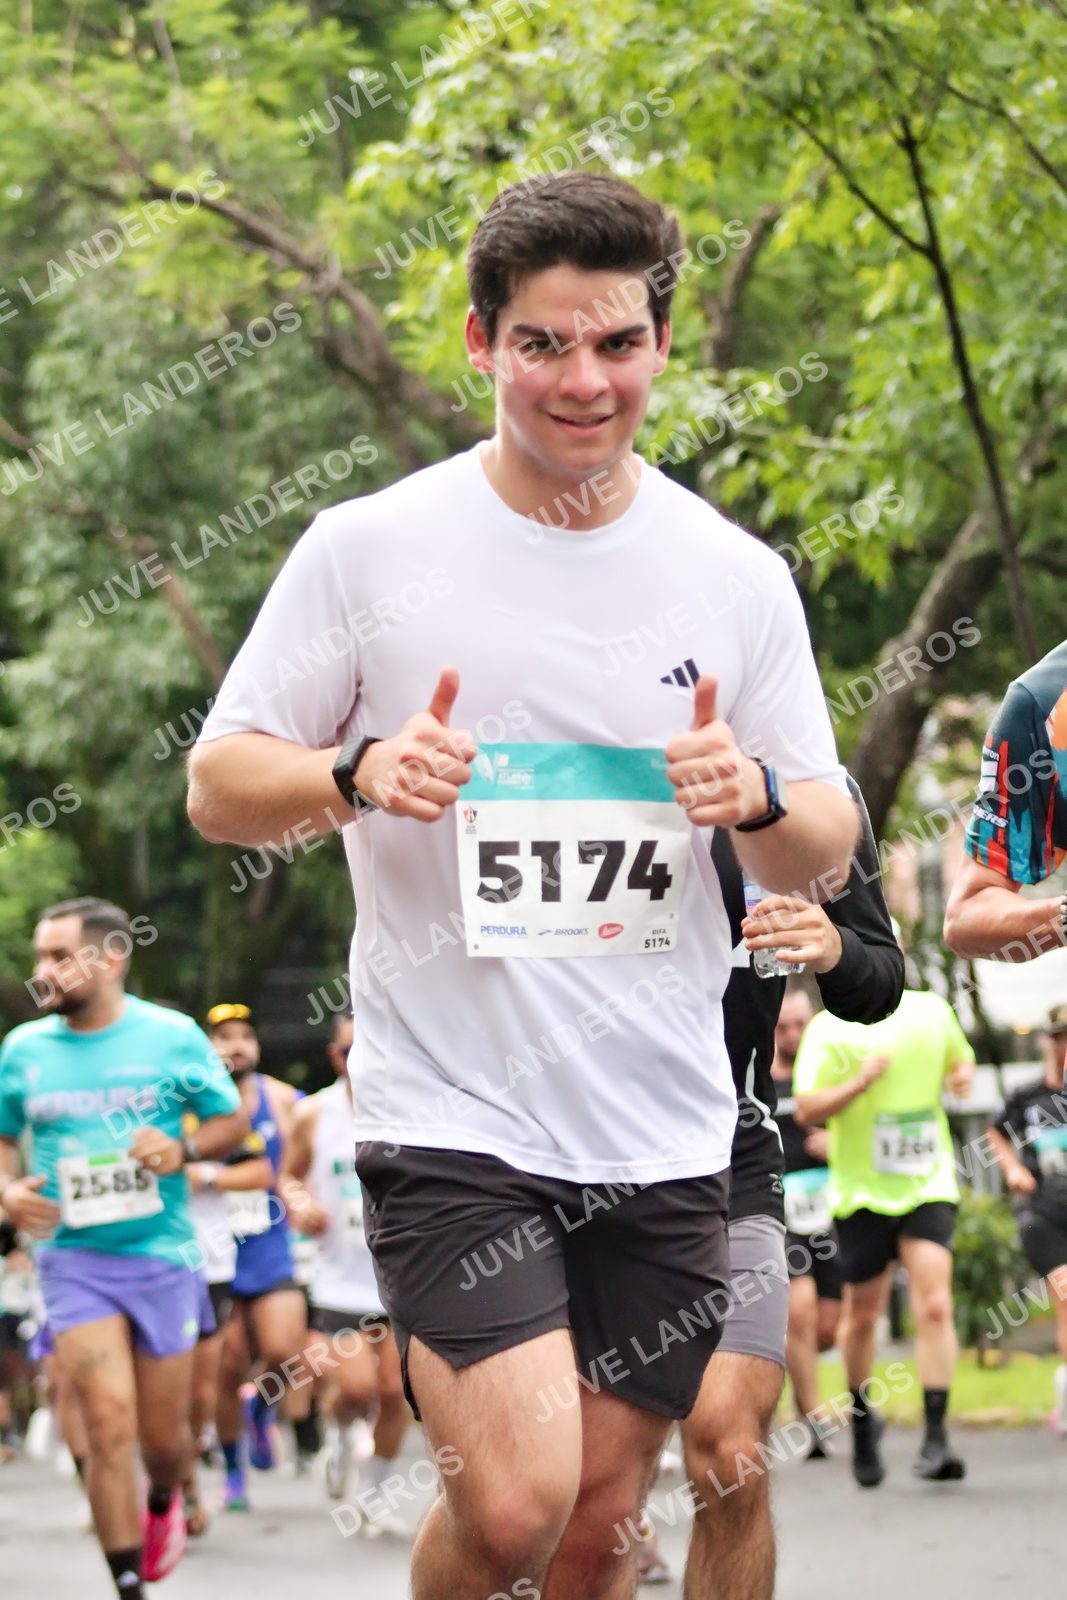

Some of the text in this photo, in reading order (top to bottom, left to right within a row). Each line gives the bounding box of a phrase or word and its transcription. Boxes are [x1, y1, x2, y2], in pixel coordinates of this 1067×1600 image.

[477, 840, 673, 904] 5174
[480, 924, 528, 936] PERDURA
[554, 927, 590, 936] BROOKS
[644, 937, 671, 949] 5174
[69, 1166, 150, 1201] 2585
